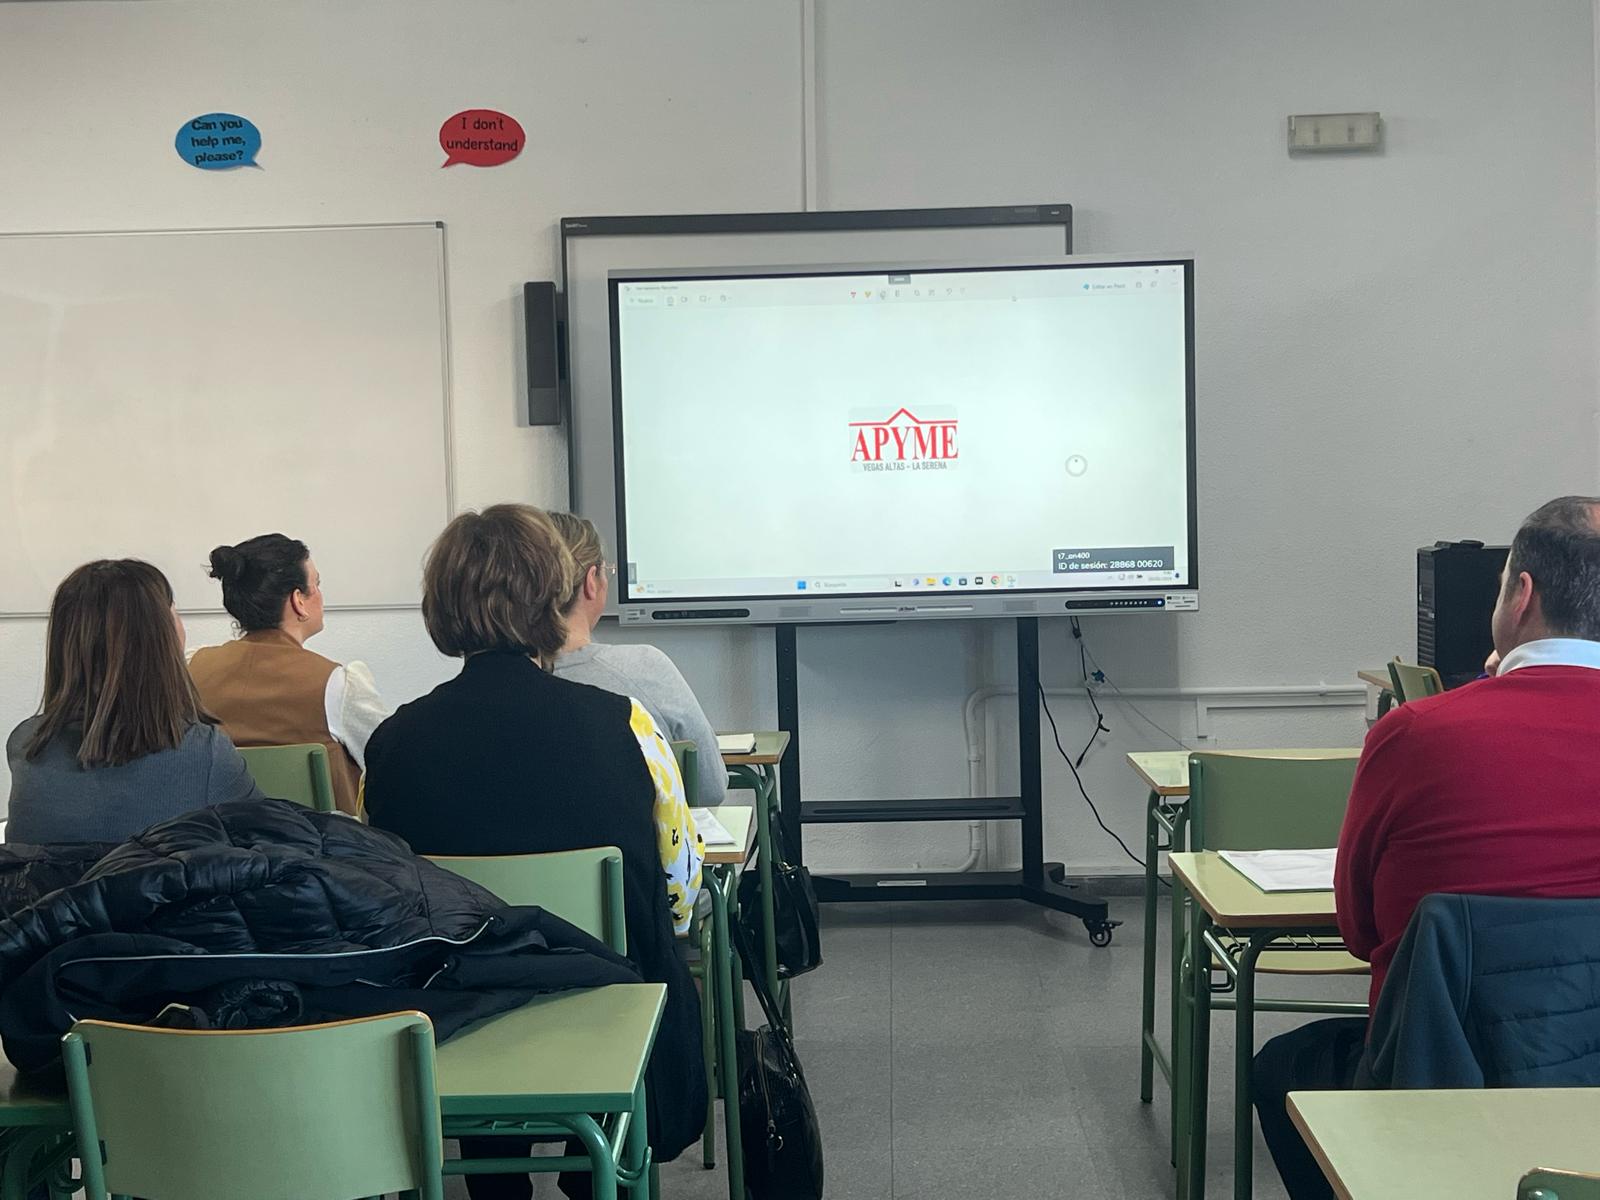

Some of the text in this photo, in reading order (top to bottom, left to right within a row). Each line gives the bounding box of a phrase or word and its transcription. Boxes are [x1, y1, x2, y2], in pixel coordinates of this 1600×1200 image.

[192, 119, 243, 131] Can you
[462, 117, 503, 130] I don't
[191, 136, 246, 148] help me,
[446, 138, 518, 152] understand
[195, 150, 244, 164] please?
[851, 425, 958, 461] APYME
[863, 462, 884, 472] VEGAS
[885, 462, 905, 471] ALTAS
[912, 462, 921, 470] LA
[921, 461, 948, 470] SERENA
[1058, 562, 1068, 570] ID
[1069, 561, 1079, 569] de
[1136, 559, 1163, 568] 00620
